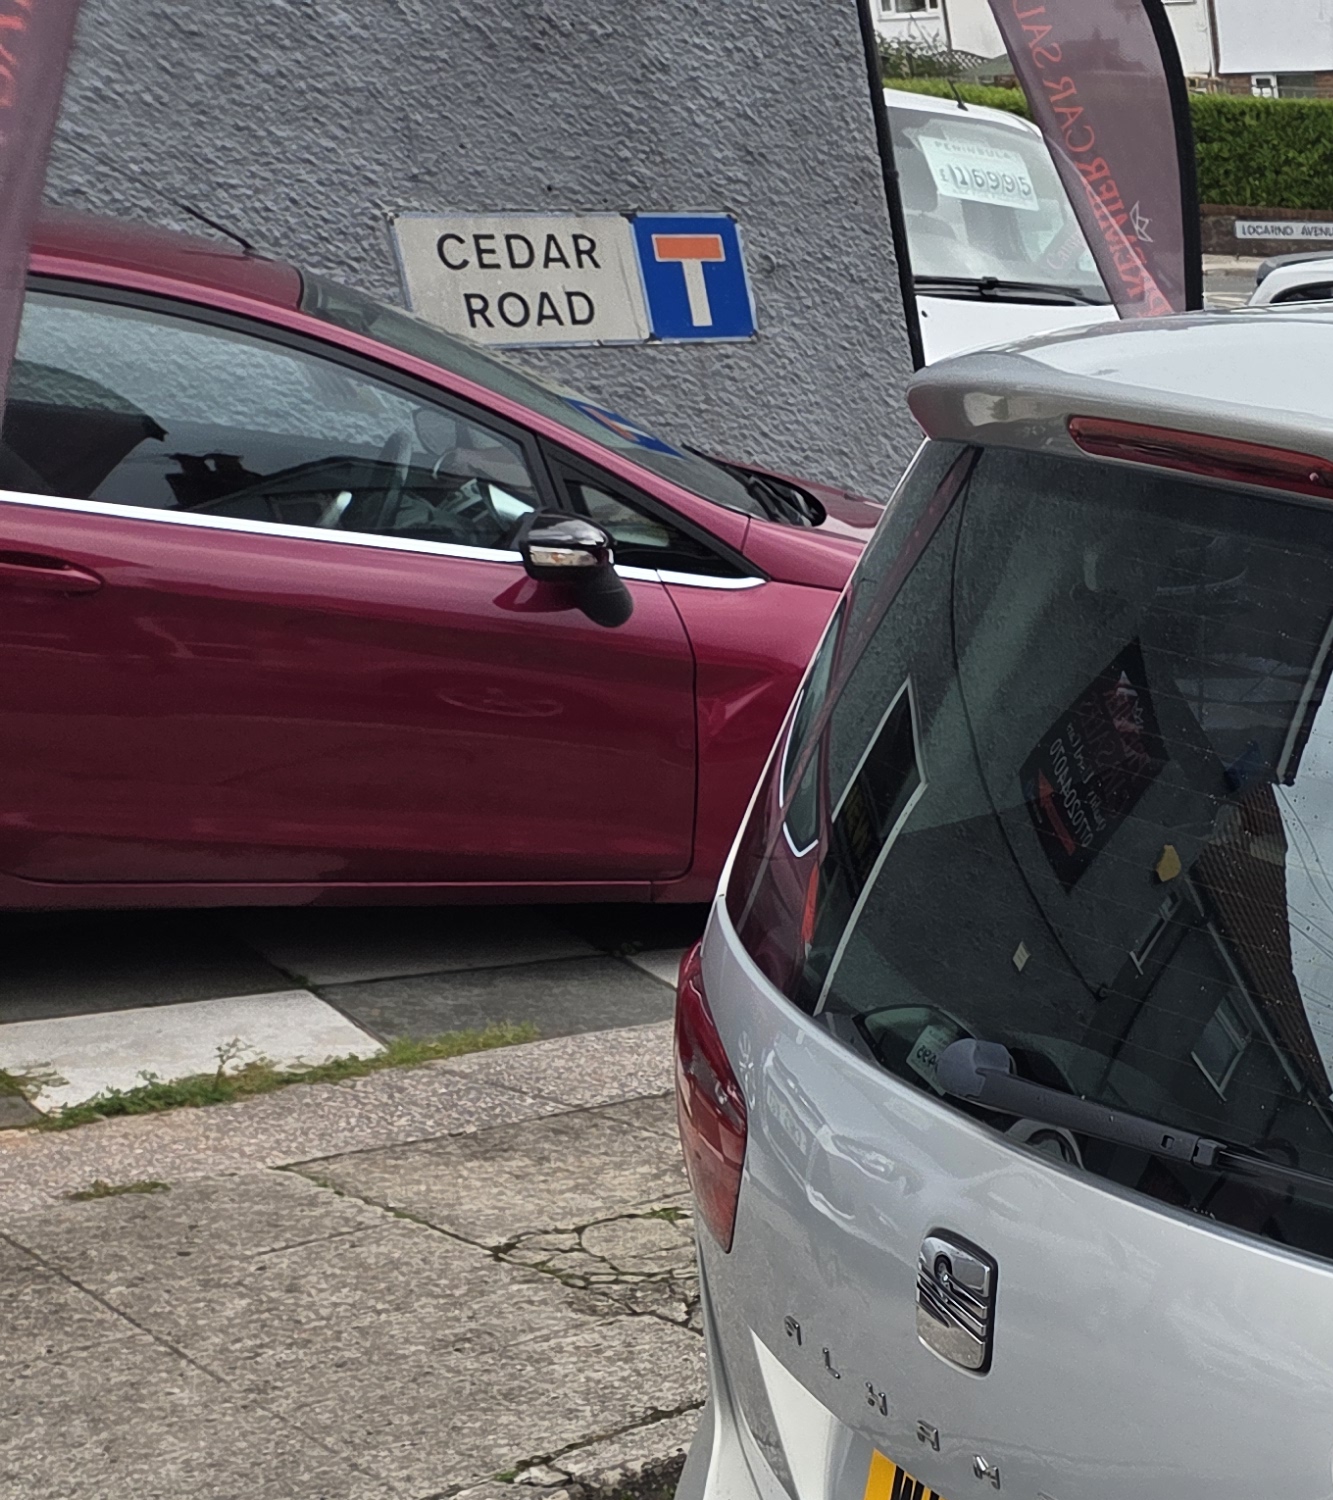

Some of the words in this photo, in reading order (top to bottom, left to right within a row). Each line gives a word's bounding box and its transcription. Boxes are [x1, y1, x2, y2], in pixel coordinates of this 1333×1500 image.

[1242, 224, 1294, 236] LOCARNO
[436, 233, 602, 272] CEDAR
[467, 291, 596, 328] ROAD
